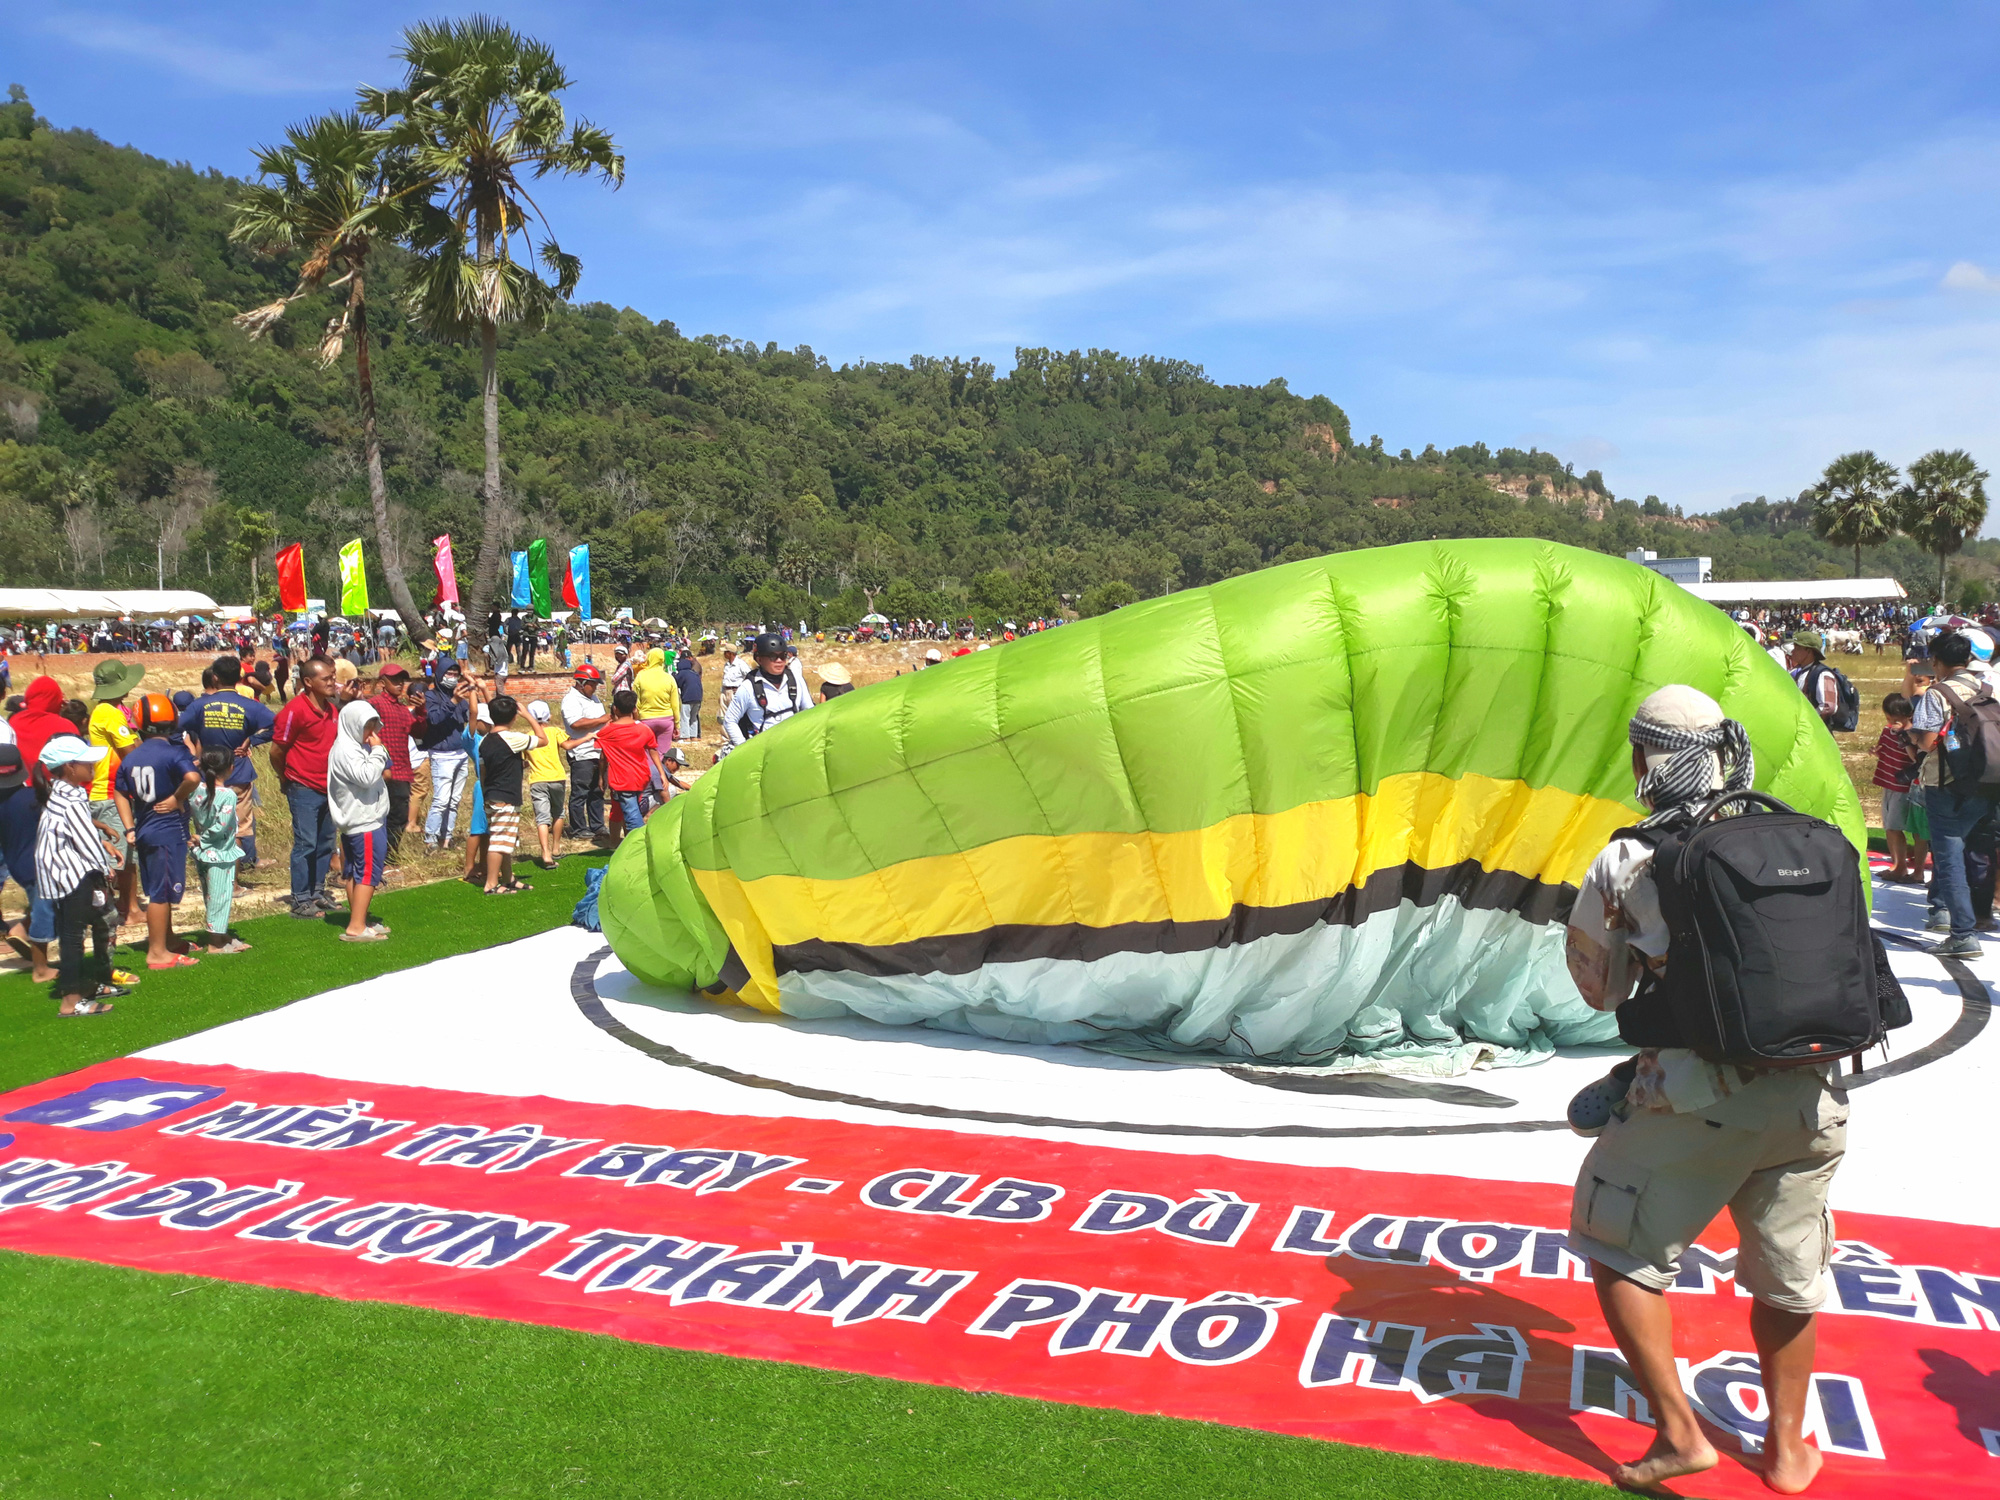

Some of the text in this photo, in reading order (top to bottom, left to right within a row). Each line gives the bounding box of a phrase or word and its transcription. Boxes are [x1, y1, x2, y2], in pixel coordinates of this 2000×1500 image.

[131, 766, 156, 802] 10
[85, 1177, 305, 1231] DÙ
[235, 1196, 571, 1264] LƯỢN
[540, 1229, 978, 1328] THÀNH
[965, 1278, 1302, 1366] PHỐ
[1299, 1312, 1531, 1404] HÀ
[158, 1099, 416, 1151] MIỀN
[382, 1124, 604, 1174] TÂY
[561, 1142, 808, 1195] BAY
[860, 1168, 1065, 1223] CLB
[1069, 1188, 1260, 1247] DÙ
[1663, 1240, 2000, 1331] MỀN
